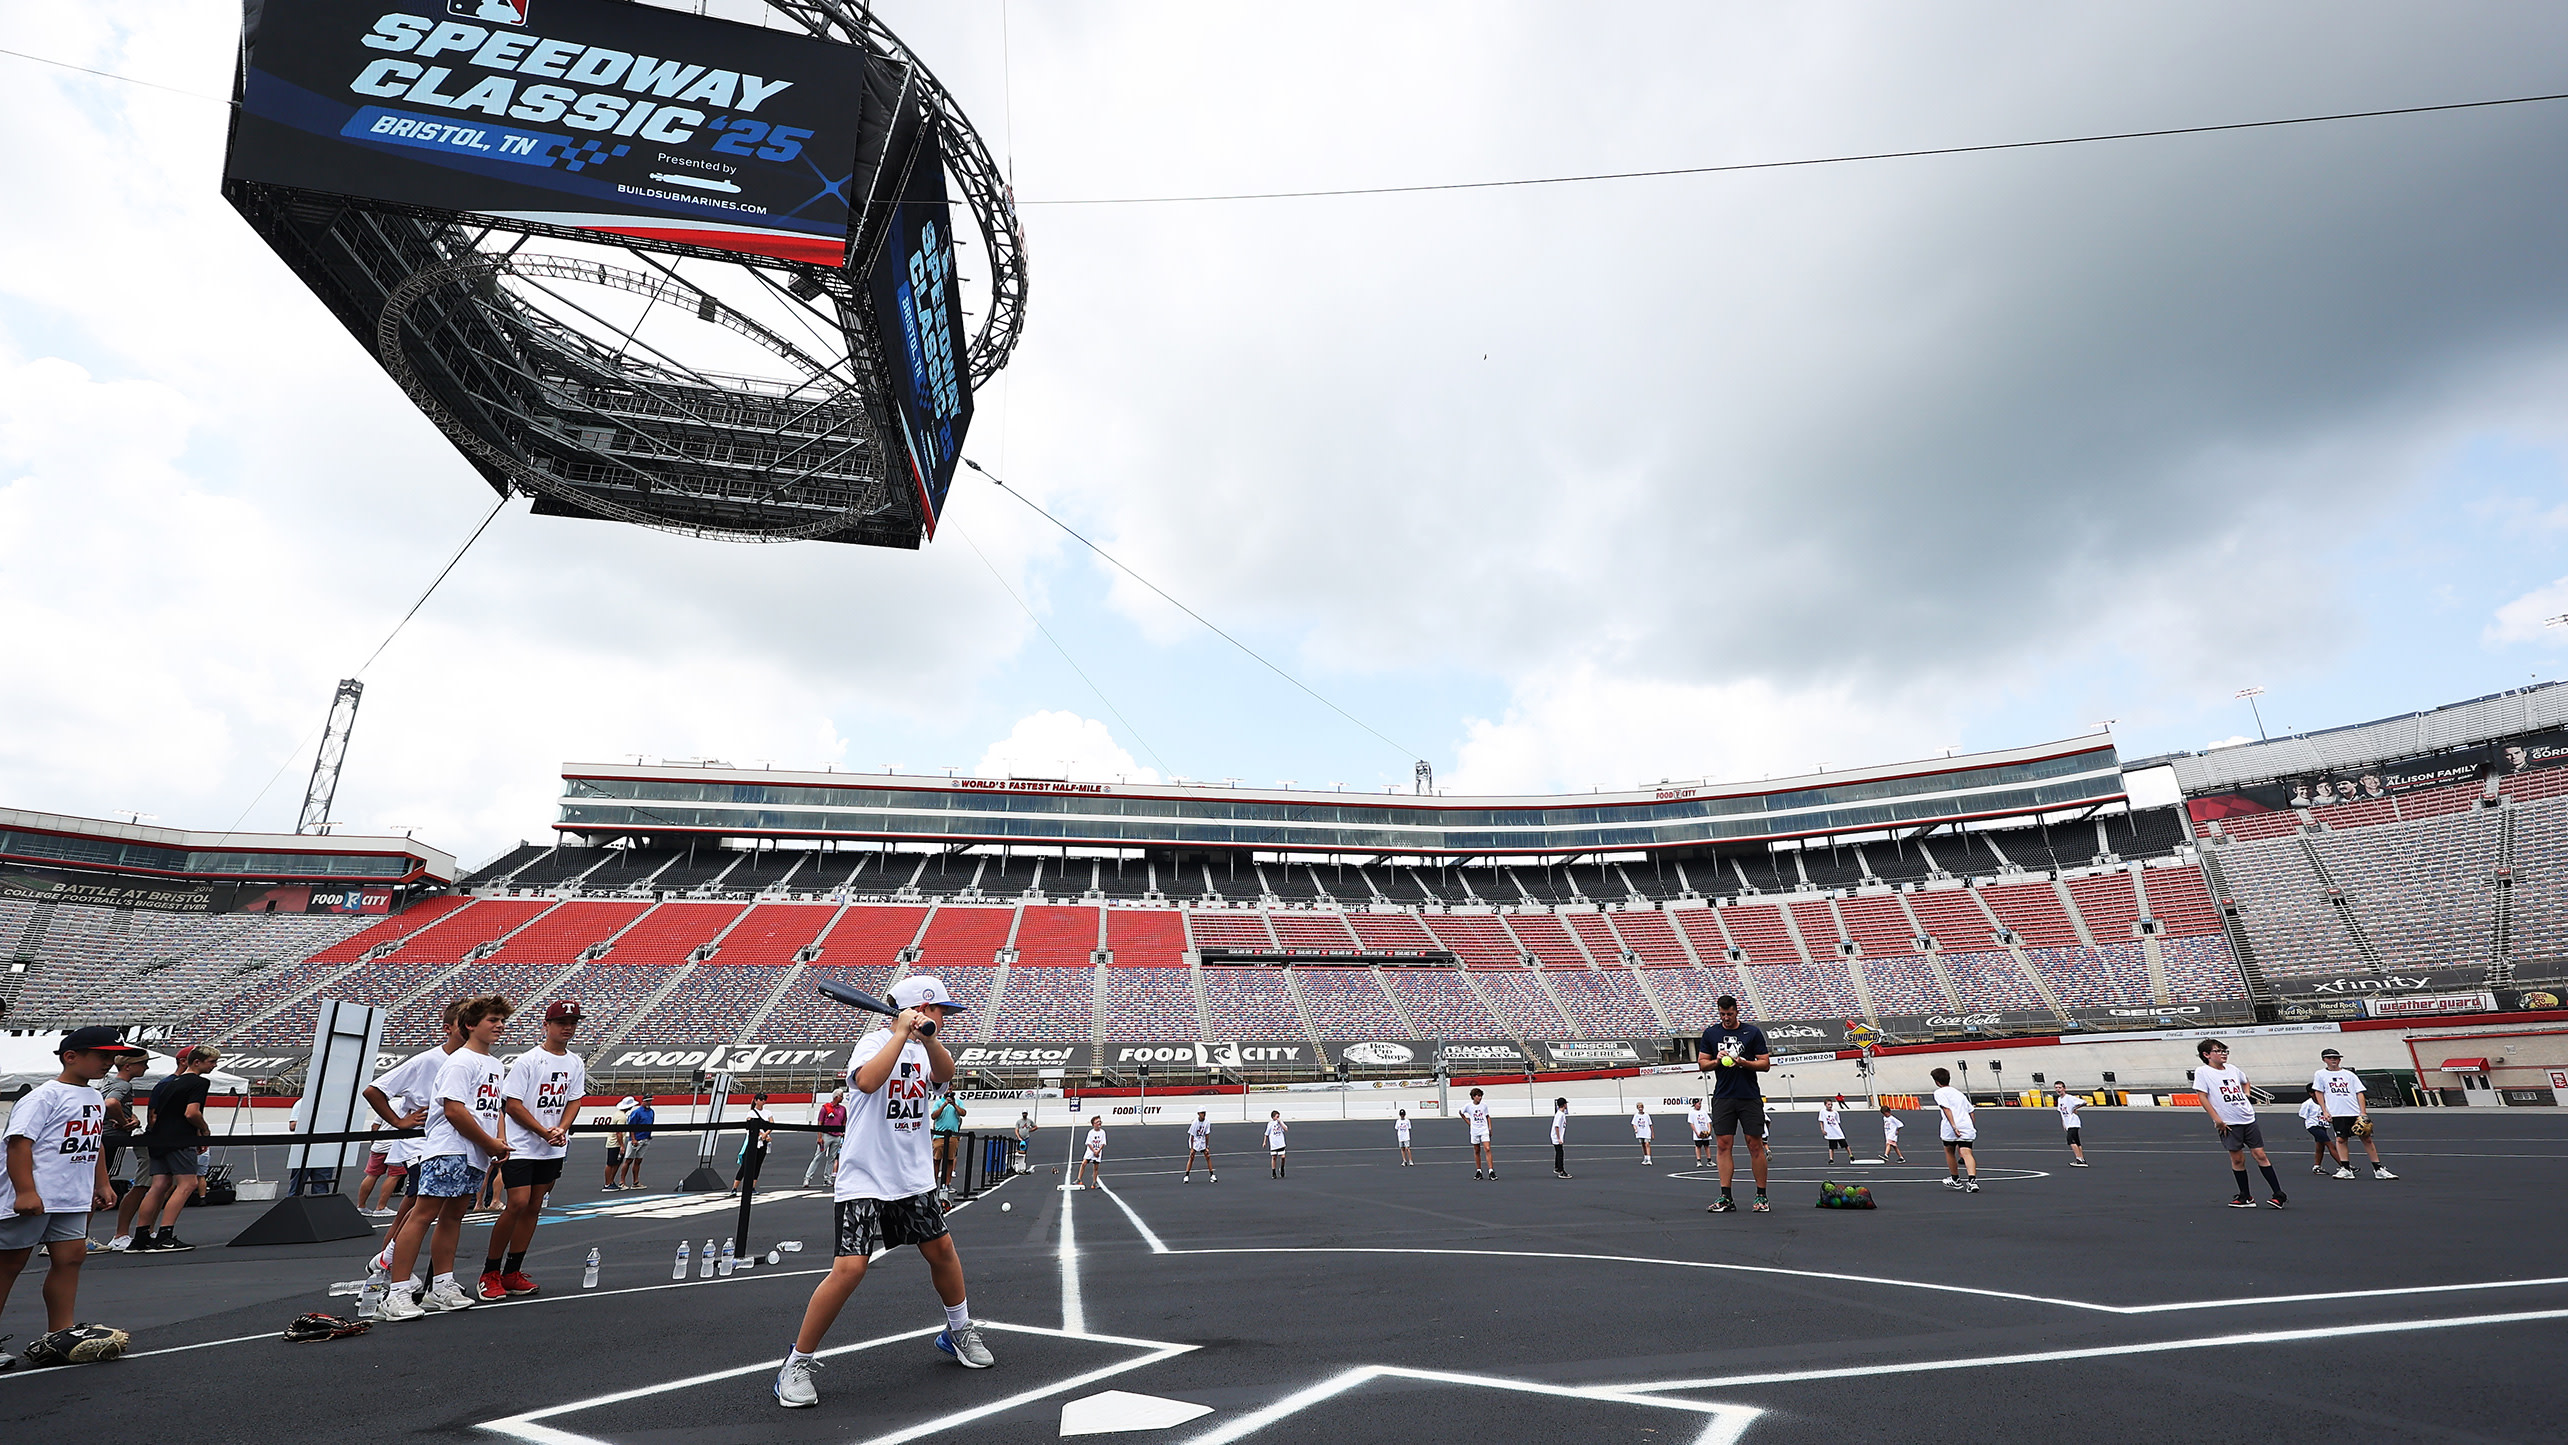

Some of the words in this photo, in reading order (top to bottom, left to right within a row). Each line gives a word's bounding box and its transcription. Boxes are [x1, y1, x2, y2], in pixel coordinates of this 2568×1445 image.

[361, 12, 794, 112] SPEEDWAY
[350, 58, 706, 144] CLASSIC
[370, 115, 490, 151] BRISTOL,
[499, 134, 538, 156] TN
[657, 152, 719, 171] Presented
[722, 163, 737, 175] by
[617, 184, 767, 215] BUILDSUBMARINES.COM
[921, 219, 961, 419] SPEEDWAY
[901, 299, 917, 362] BRISTOL,
[912, 362, 923, 378] TN
[909, 249, 944, 419] CLASSIC
[2386, 772, 2434, 787] ALLISON
[2437, 763, 2478, 779] FAMILY
[962, 780, 1005, 789] WORLD'S
[1009, 782, 1050, 791] FASTEST
[1682, 789, 1697, 797] CITY
[3, 888, 59, 900] COLLEGE
[62, 893, 132, 906] FOOTBALL'S
[134, 899, 183, 911] BIGGEST
[183, 903, 207, 911] EVER
[51, 883, 120, 897] BATTLE
[121, 889, 146, 899] AT
[148, 891, 210, 903] BRISTOL
[311, 894, 344, 905] FOOD
[361, 895, 388, 906] CITY
[2312, 976, 2432, 994] xfinity
[562, 1003, 576, 1014] T
[2108, 1006, 2201, 1017] GEICO
[2339, 1001, 2358, 1009] Rock
[2380, 1000, 2437, 1011] weather
[2440, 999, 2480, 1011] guard
[1766, 1027, 1828, 1039] BUSCH
[1847, 1032, 1881, 1042] SUNOCO
[959, 1047, 1074, 1060] Bristol
[1118, 1048, 1193, 1061] FOOD
[1242, 1047, 1299, 1061] CITY
[1444, 1045, 1511, 1054] TRACKER
[1718, 1042, 1742, 1053] PLAY
[611, 1050, 707, 1067] FOOD
[760, 1050, 836, 1065] CITY
[1785, 1055, 1808, 1063] FIRST
[1808, 1053, 1834, 1062] HORIZON
[959, 1090, 1023, 1100] SPEEDWAY
[476, 1098, 499, 1111] BAL
[886, 1099, 924, 1119] BAL
[1113, 1107, 1134, 1115] FOOD
[1144, 1106, 1161, 1114] CITY
[593, 1117, 612, 1125] FOO
[59, 1137, 100, 1154] BAL
